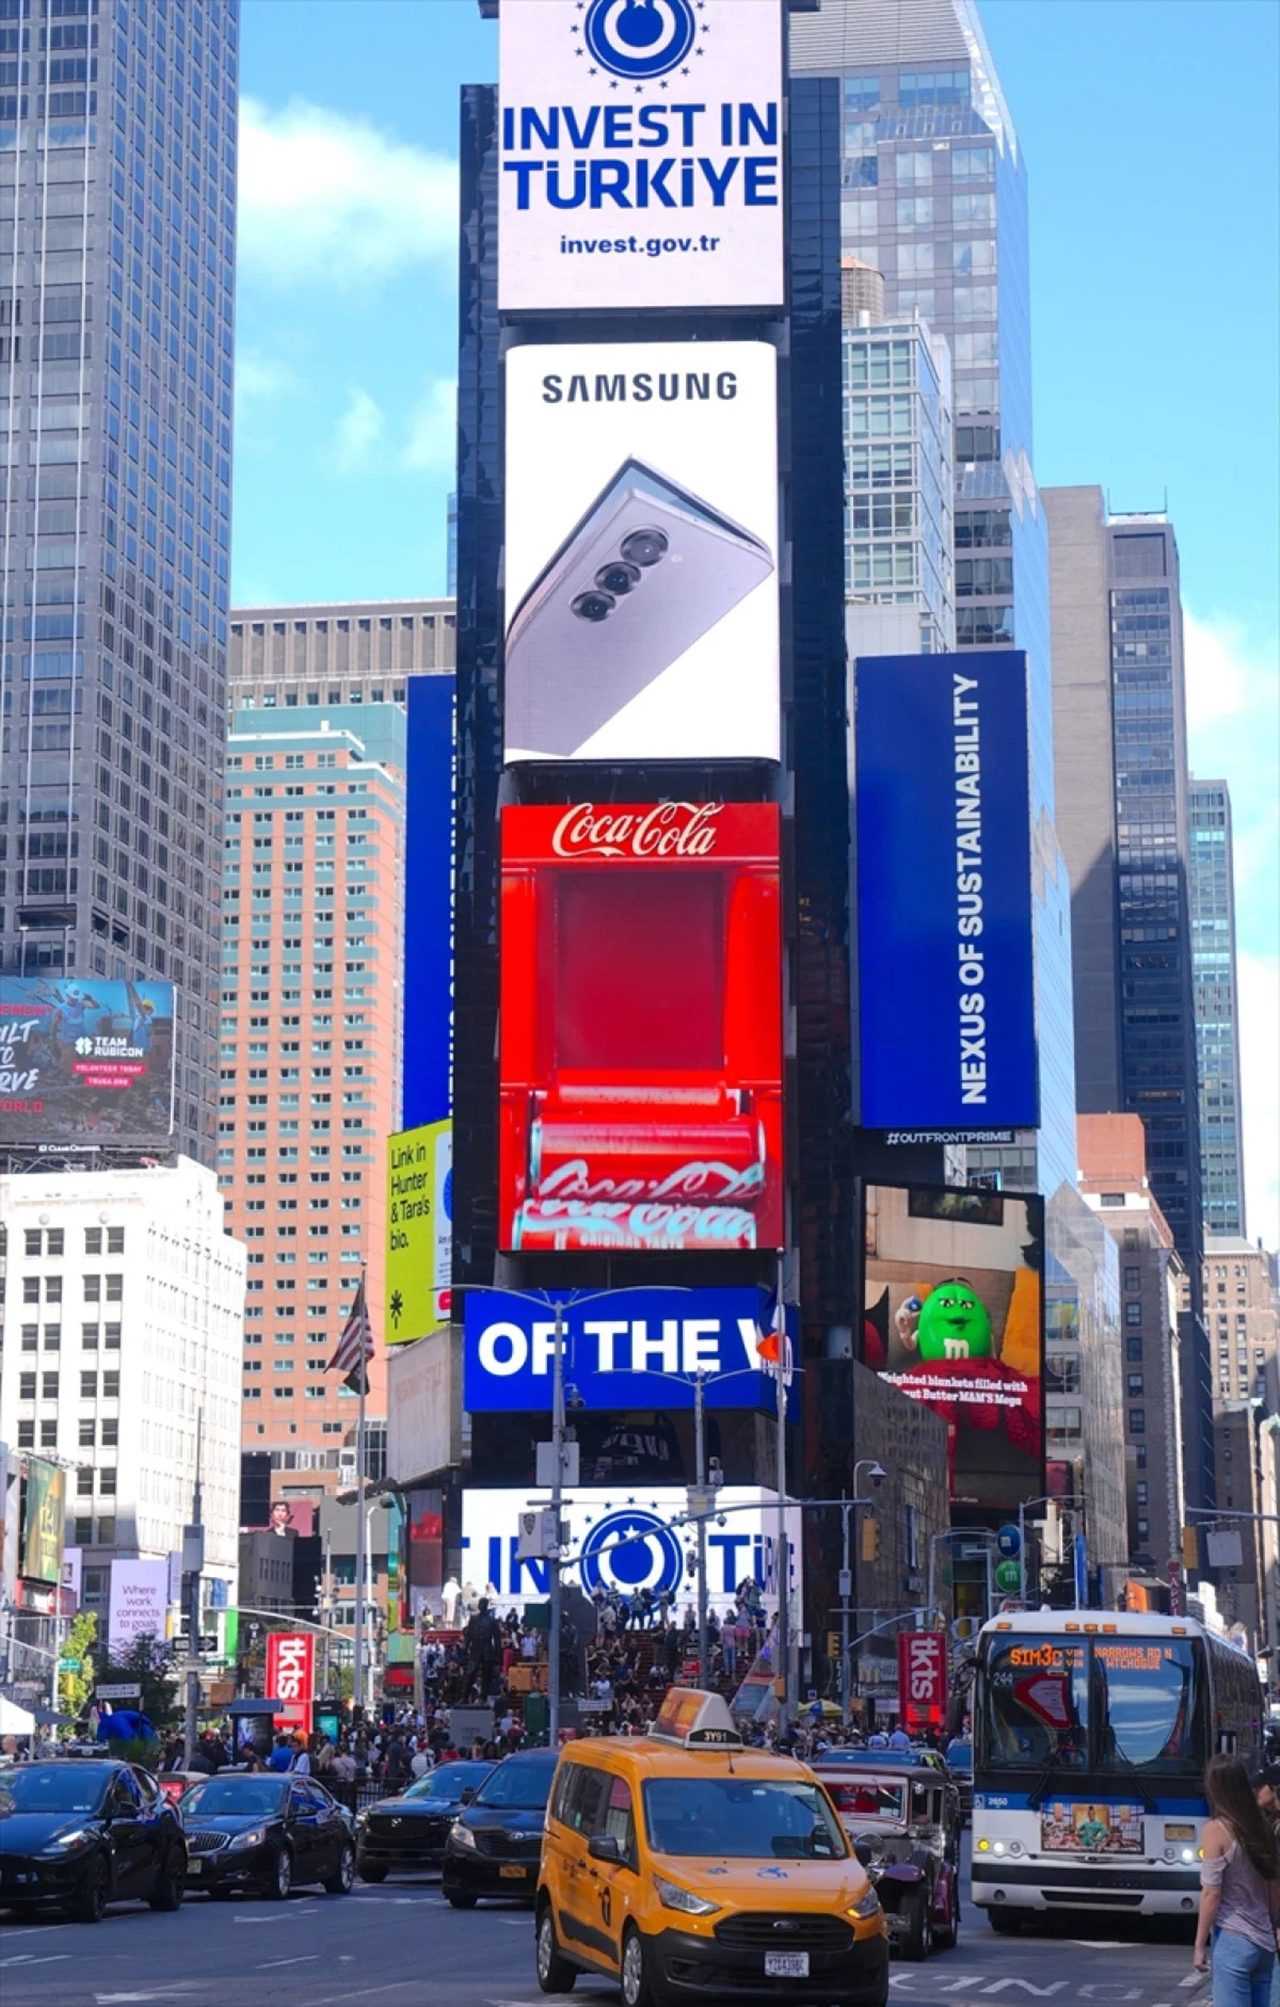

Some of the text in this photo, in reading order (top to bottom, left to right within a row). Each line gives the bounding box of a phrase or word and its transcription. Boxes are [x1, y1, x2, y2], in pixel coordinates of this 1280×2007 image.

[503, 102, 778, 151] INVEST IN
[560, 234, 721, 257] invest.gov.tr
[541, 372, 738, 404] SAMSUNG
[552, 802, 725, 857] Coca-Cola
[953, 674, 987, 1104] NEXUS OF SUSTAINABILITY
[94, 1046, 144, 1057] RUBICON
[95, 1037, 127, 1046] TEAM
[391, 1142, 426, 1170] Link in
[391, 1171, 428, 1196] Hunter
[391, 1195, 430, 1224] & Tara's
[391, 1229, 409, 1251] bio.
[478, 1320, 569, 1376] OF
[583, 1318, 721, 1374] THE
[923, 1389, 959, 1402] Butter
[975, 1378, 1002, 1391] filled
[1003, 1381, 1028, 1393] with
[122, 1585, 157, 1595] Where
[126, 1597, 152, 1606] work
[116, 1608, 160, 1617] connects
[120, 1619, 129, 1628] to
[1010, 1642, 1063, 1668] SIM3C
[277, 1638, 306, 1700] tkts
[910, 1637, 939, 1700] tkts
